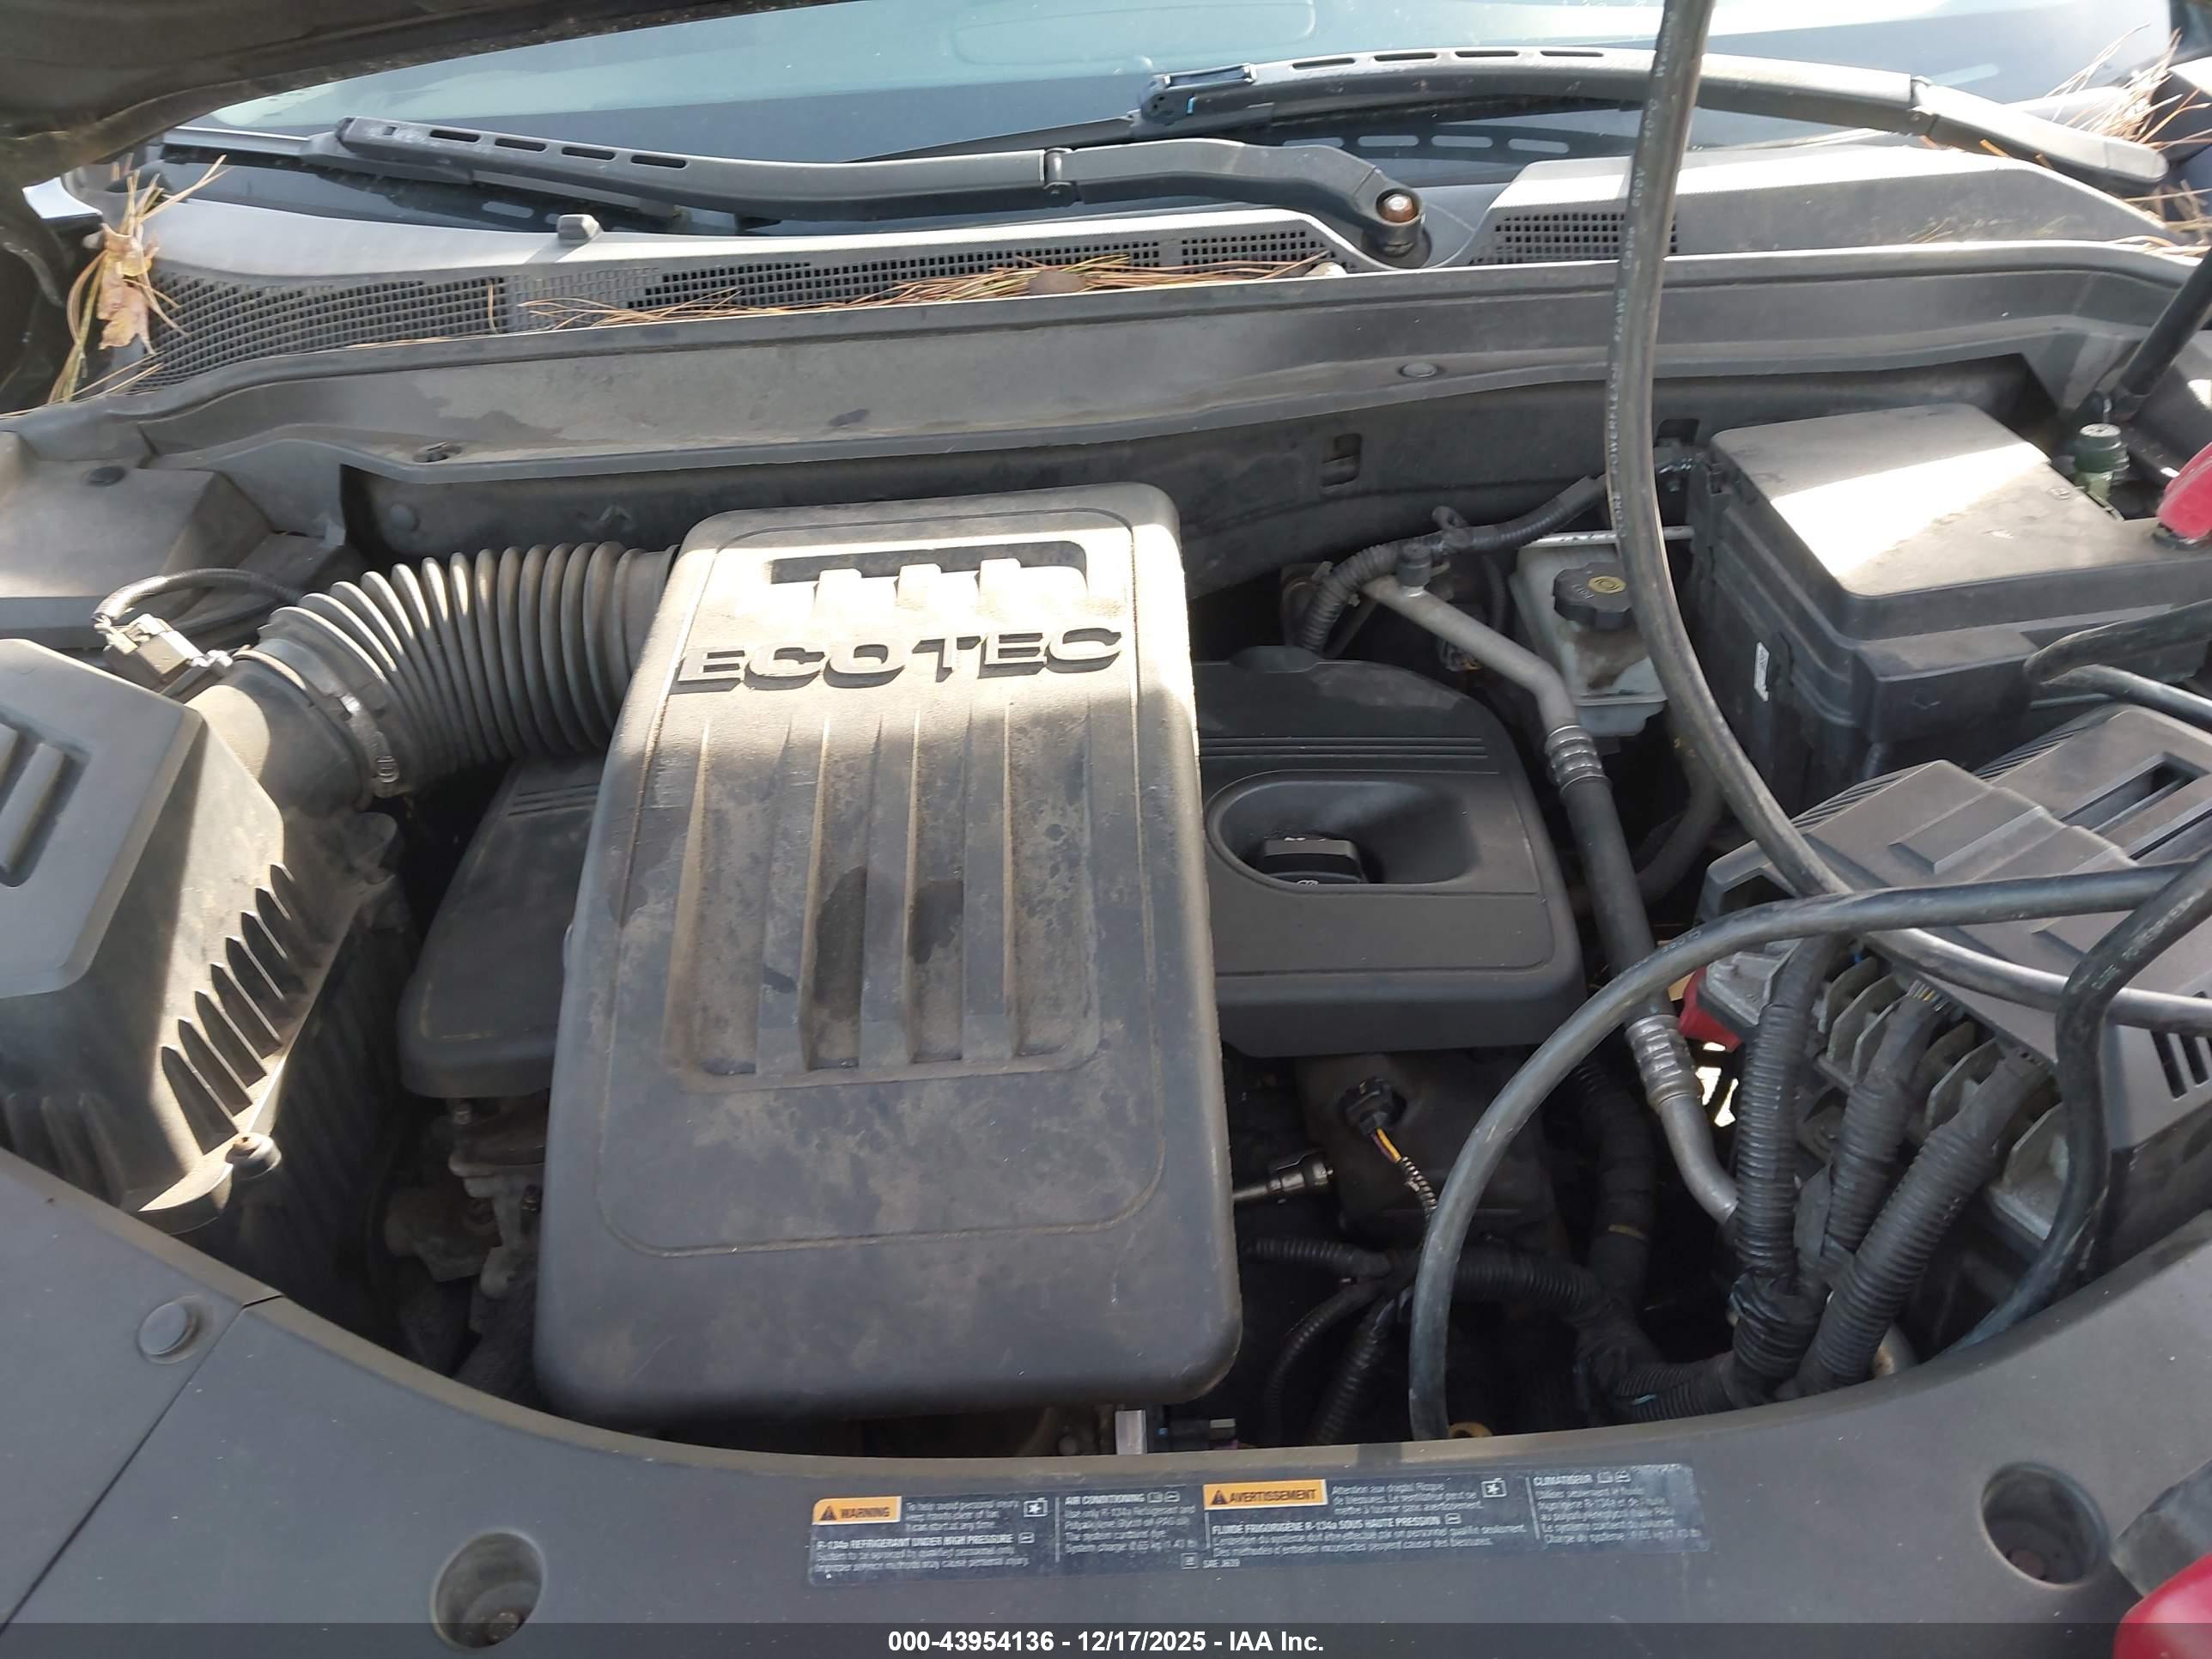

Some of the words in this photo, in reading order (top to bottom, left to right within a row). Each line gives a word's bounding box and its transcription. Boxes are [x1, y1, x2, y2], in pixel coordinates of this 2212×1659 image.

[672, 628, 1121, 693] ECOTEC
[1065, 1496, 1080, 1505] AIR
[1082, 1493, 1145, 1504] CONDITIONING
[1229, 1489, 1317, 1503] AVERTISSEMENT
[840, 1506, 890, 1519] WARNING
[1338, 1519, 1364, 1529] SOUS
[1395, 1516, 1441, 1527] PRESSION
[967, 1534, 1014, 1545] PRESSURE
